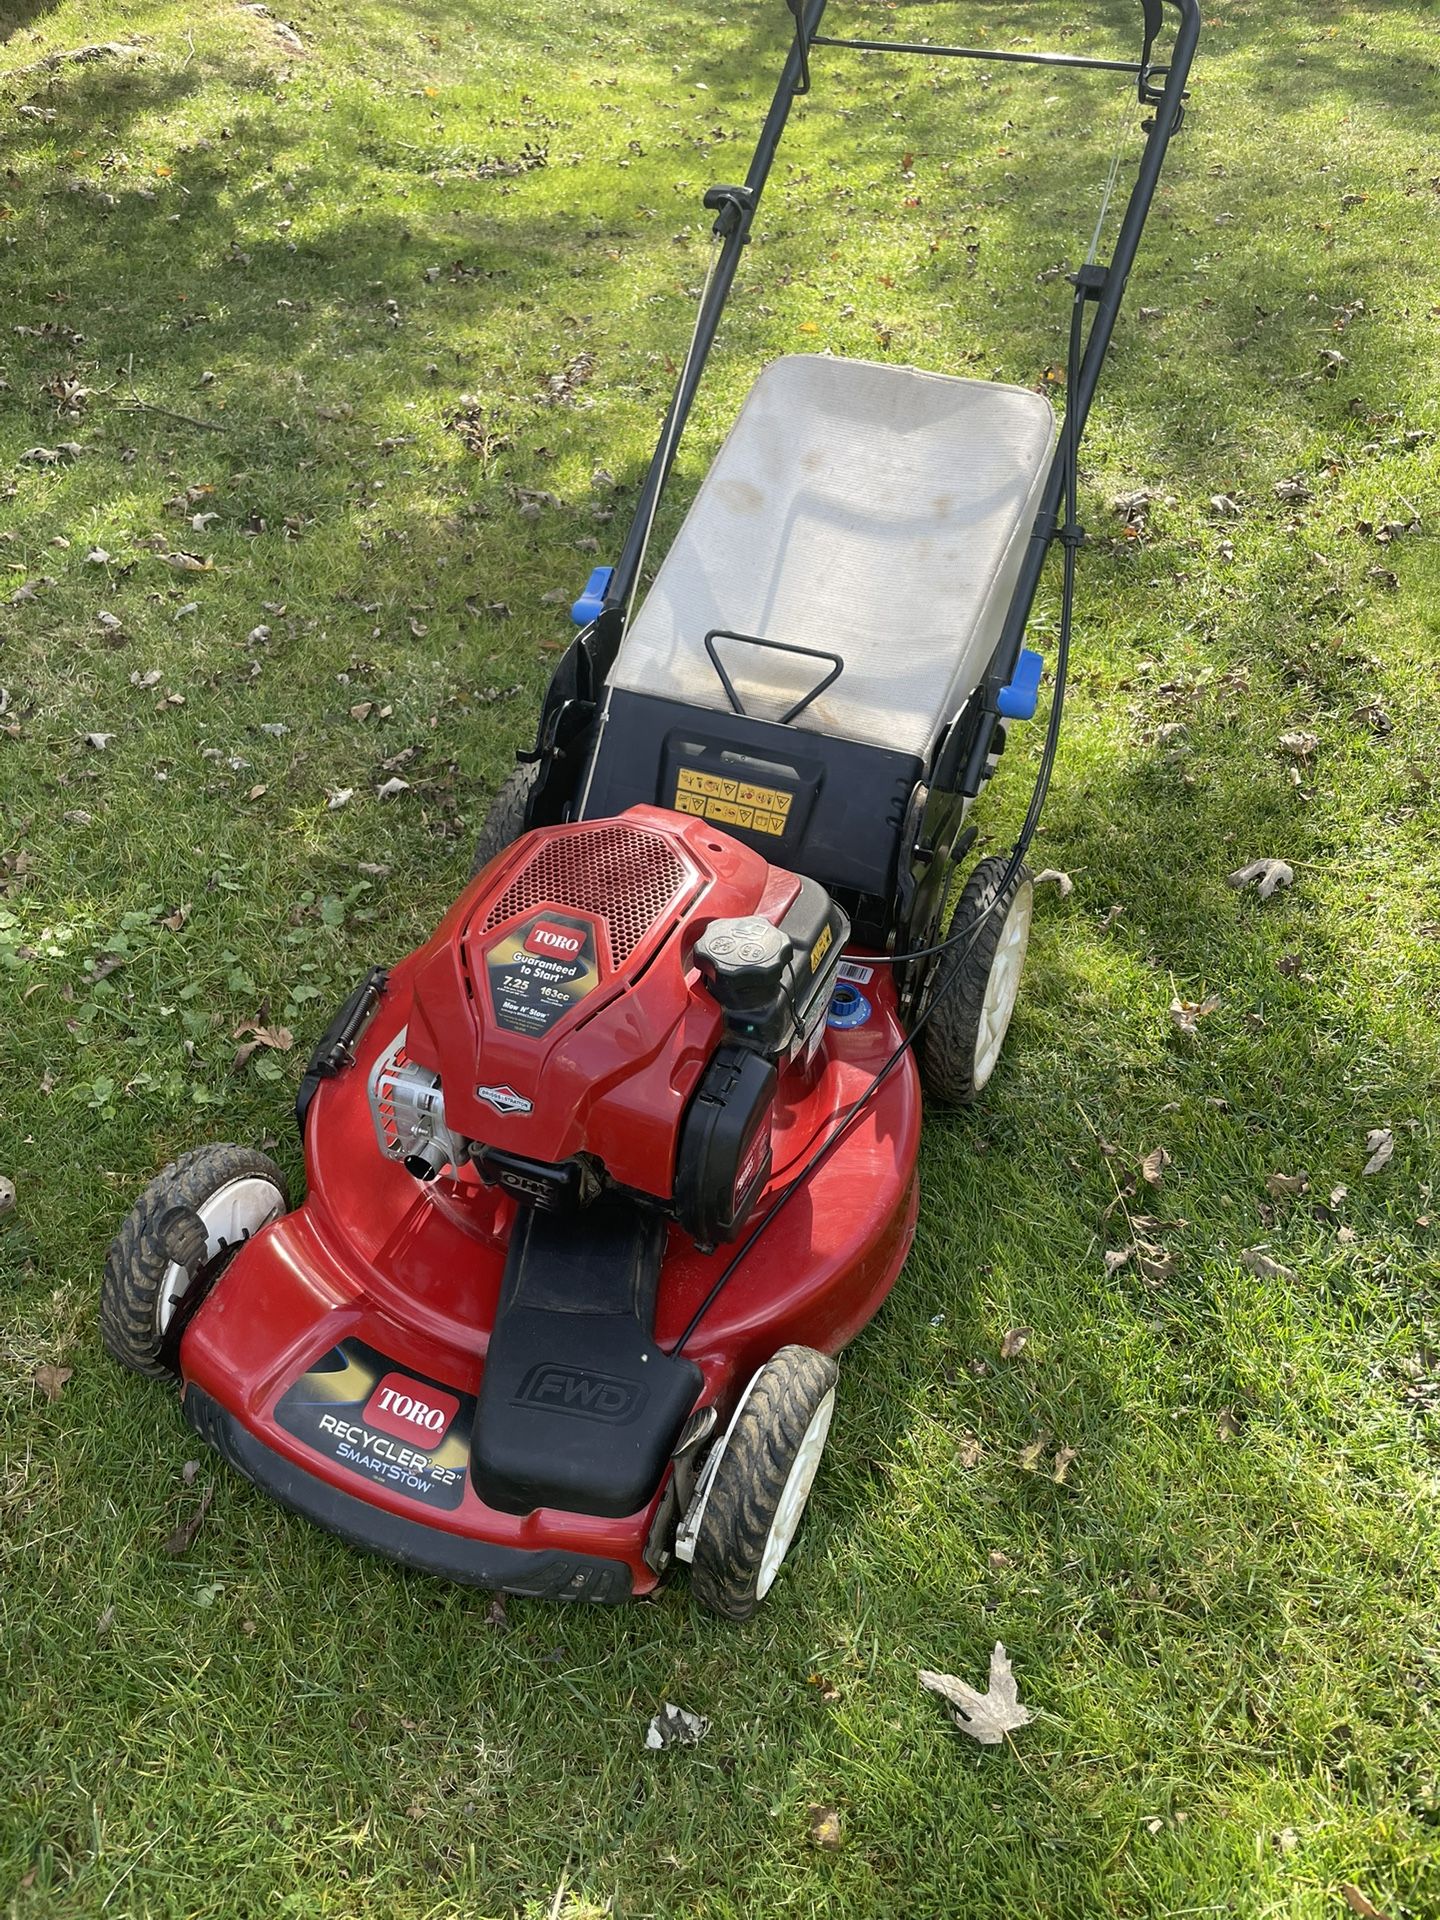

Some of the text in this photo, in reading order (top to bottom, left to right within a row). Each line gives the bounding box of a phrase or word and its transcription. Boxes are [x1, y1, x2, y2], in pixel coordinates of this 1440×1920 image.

[535, 929, 579, 952] TORO
[513, 951, 577, 977] Guaranteed
[520, 965, 531, 975] to
[503, 976, 530, 990] 7.25
[540, 986, 570, 1001] 163cc
[502, 1001, 519, 1011] Mow
[529, 1008, 548, 1019] Stow
[535, 1374, 628, 1410] FWD
[378, 1387, 445, 1432] TORO
[319, 1414, 428, 1473] RECYCLER
